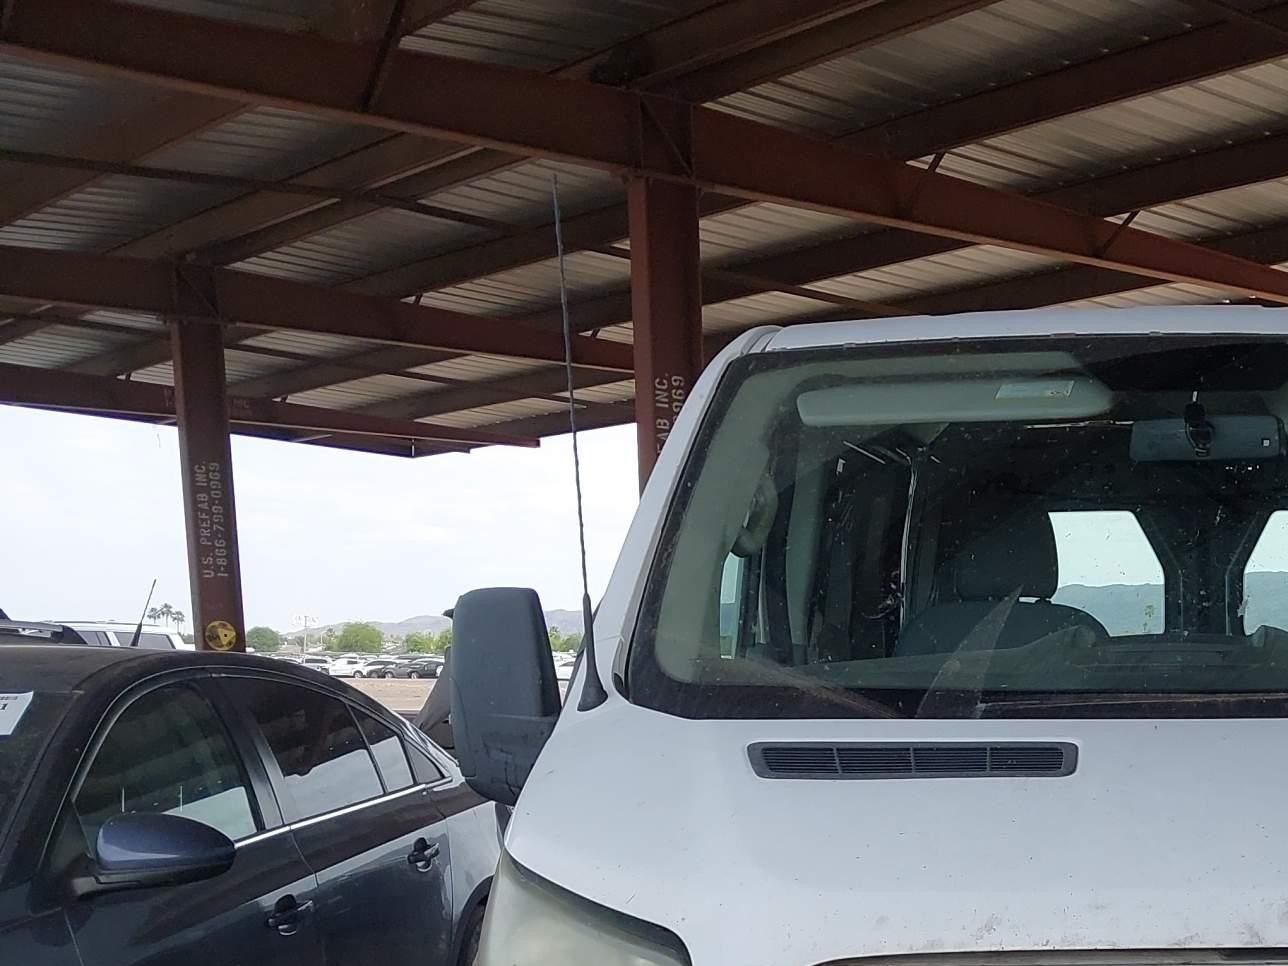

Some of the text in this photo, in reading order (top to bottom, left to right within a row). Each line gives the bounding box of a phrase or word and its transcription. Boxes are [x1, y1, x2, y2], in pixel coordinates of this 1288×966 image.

[655, 373, 669, 408] INC.
[194, 460, 214, 578] U.S. PREFAB INC.
[209, 462, 229, 577] 1-866-799-0969
